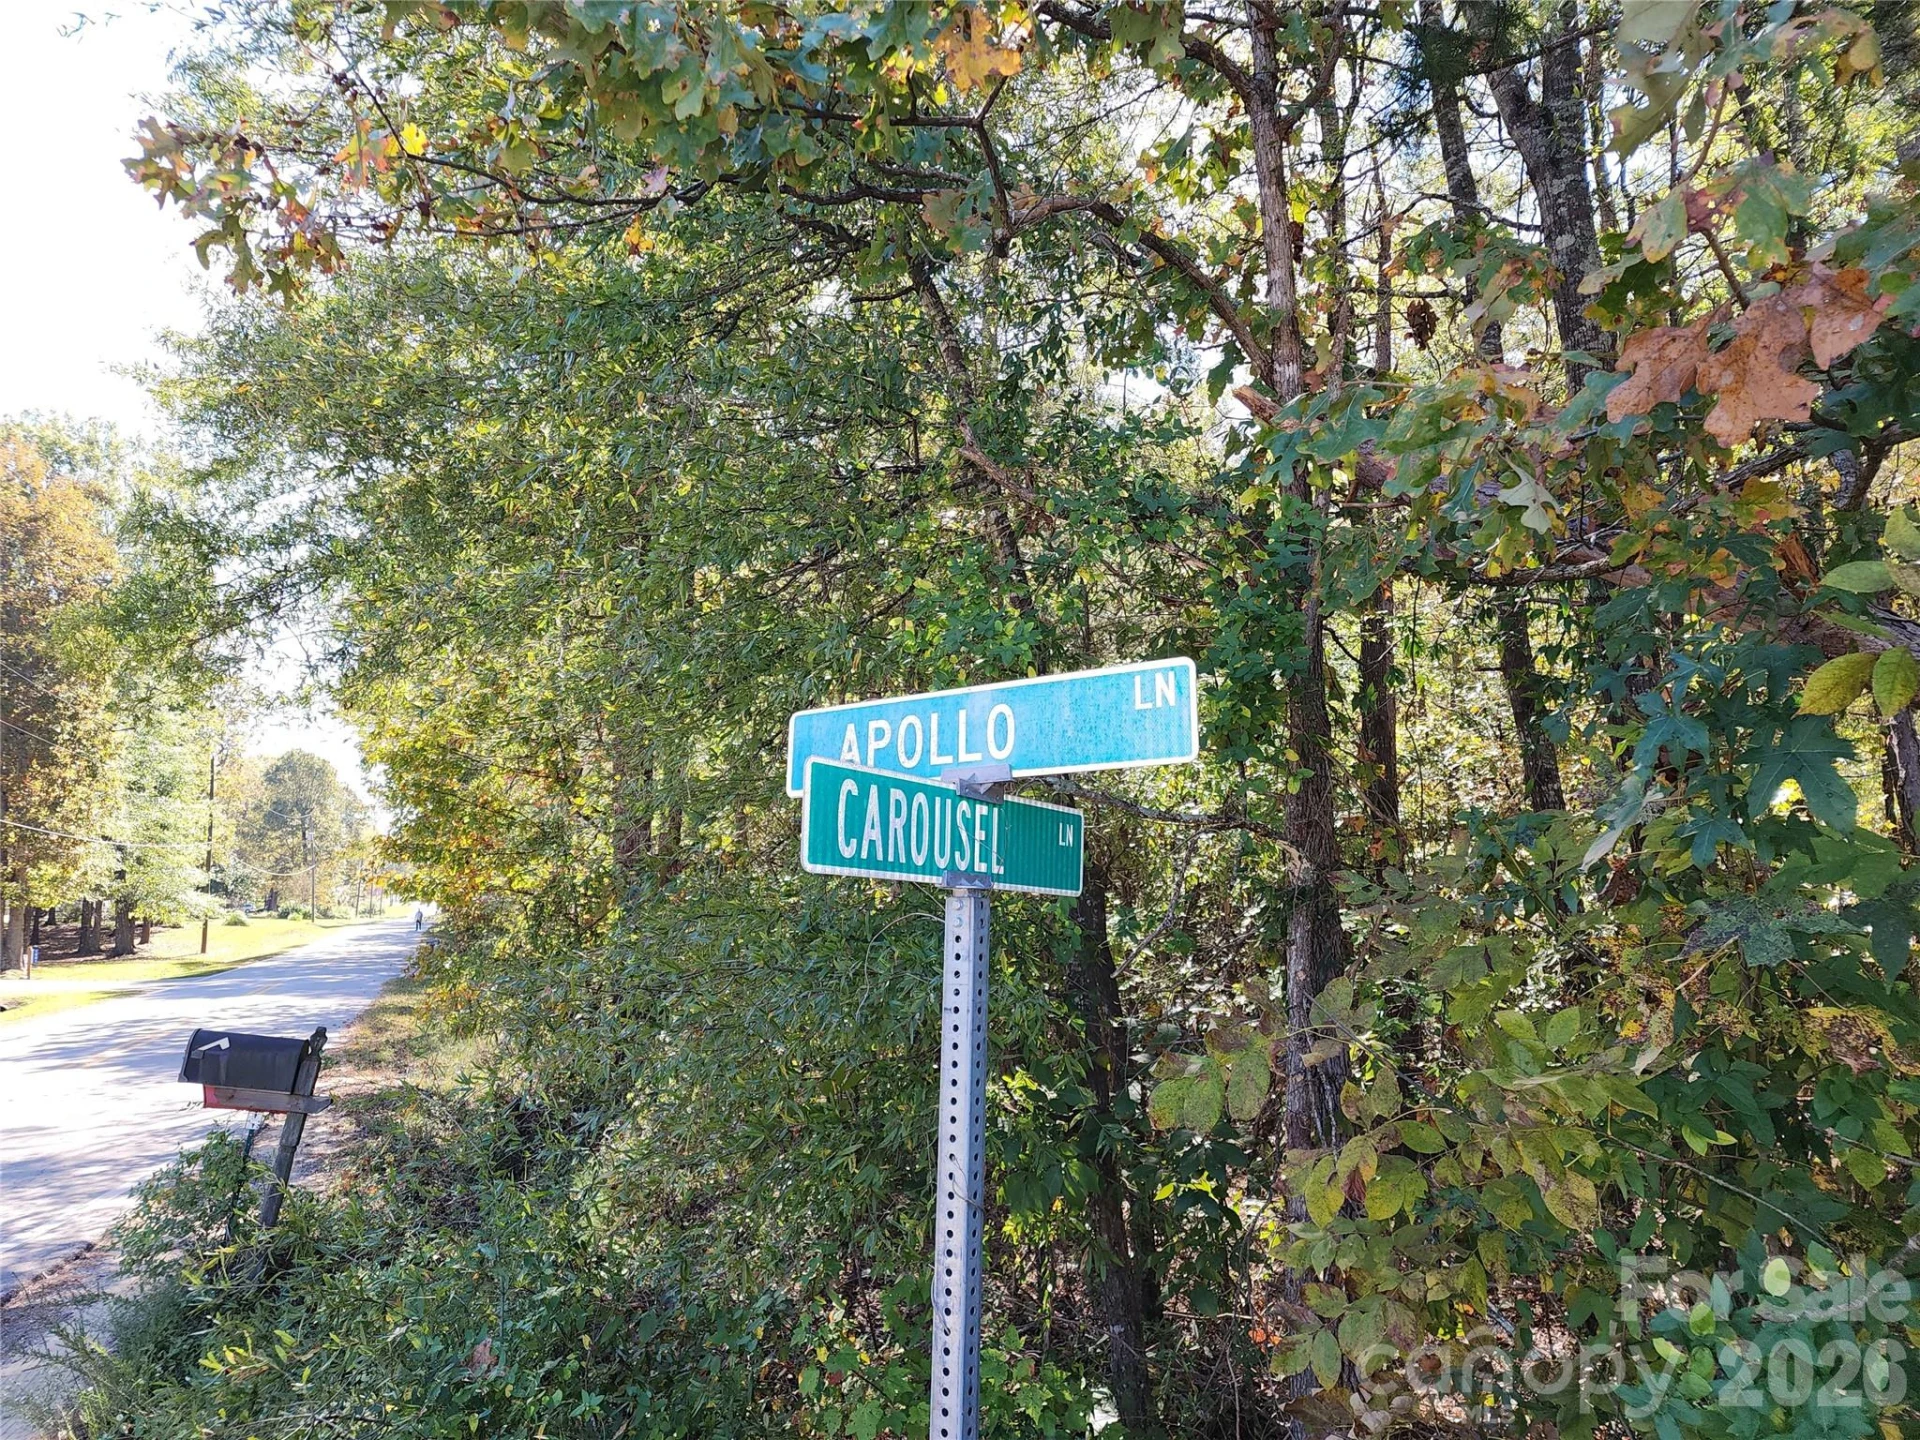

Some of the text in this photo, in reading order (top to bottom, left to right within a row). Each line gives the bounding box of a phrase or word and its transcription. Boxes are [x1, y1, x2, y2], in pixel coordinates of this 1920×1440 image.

[839, 671, 1176, 768] APOLLO LN
[838, 778, 1073, 874] CAROUSEL LN
